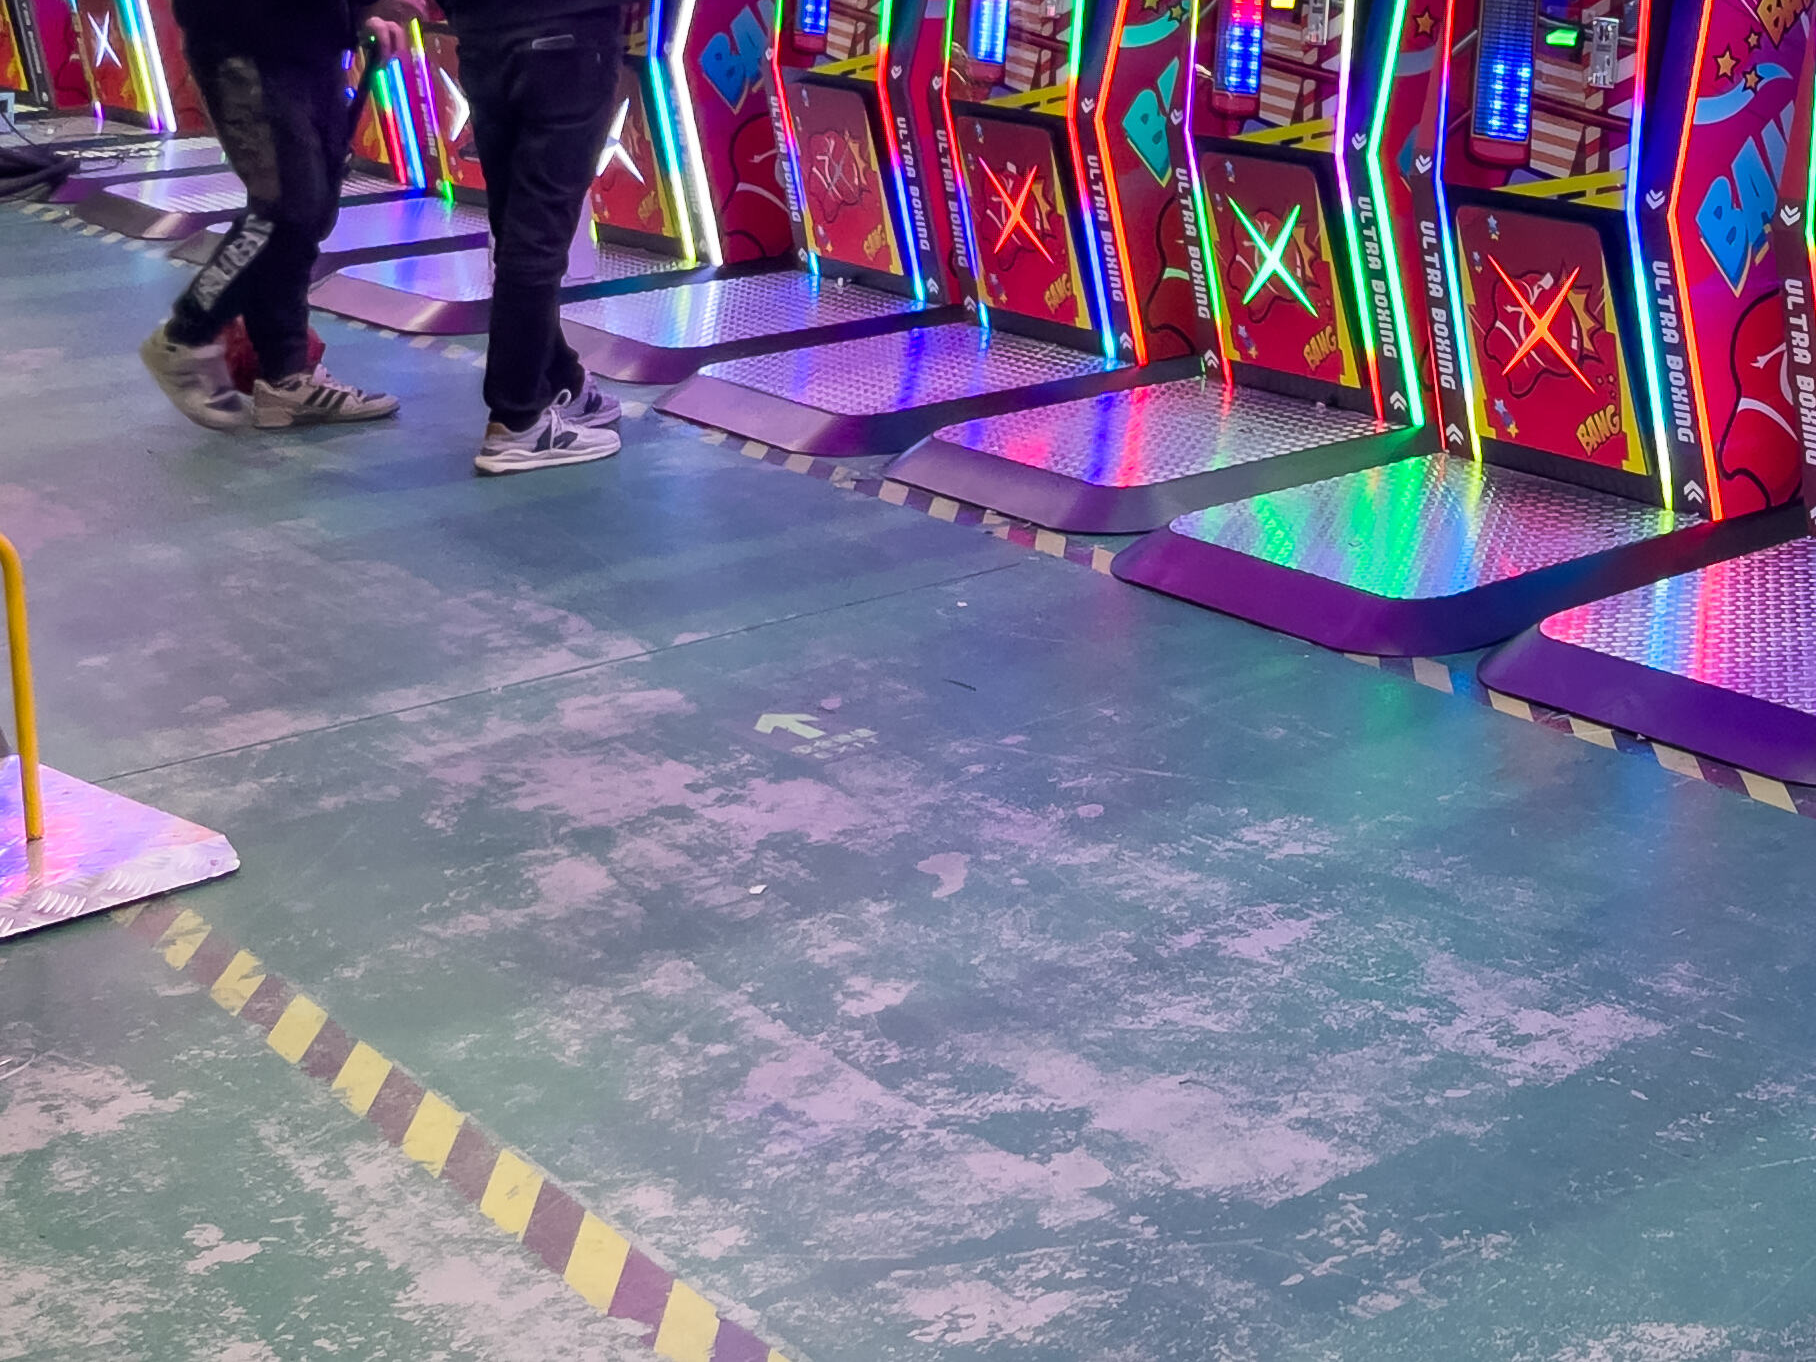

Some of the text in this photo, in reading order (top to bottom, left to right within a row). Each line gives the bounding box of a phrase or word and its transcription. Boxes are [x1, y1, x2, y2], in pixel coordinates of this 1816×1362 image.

[1087, 154, 1124, 303] ULTRA BOXING
[1176, 168, 1210, 319] ULTRA BOXING
[1357, 195, 1398, 360] ULTRA BOXING
[1419, 220, 1457, 391] ULTRA BOXING
[1653, 261, 1695, 445] ULTRA BOXING
[1785, 278, 1812, 363] ULTRA
[1576, 403, 1621, 458] BANG
